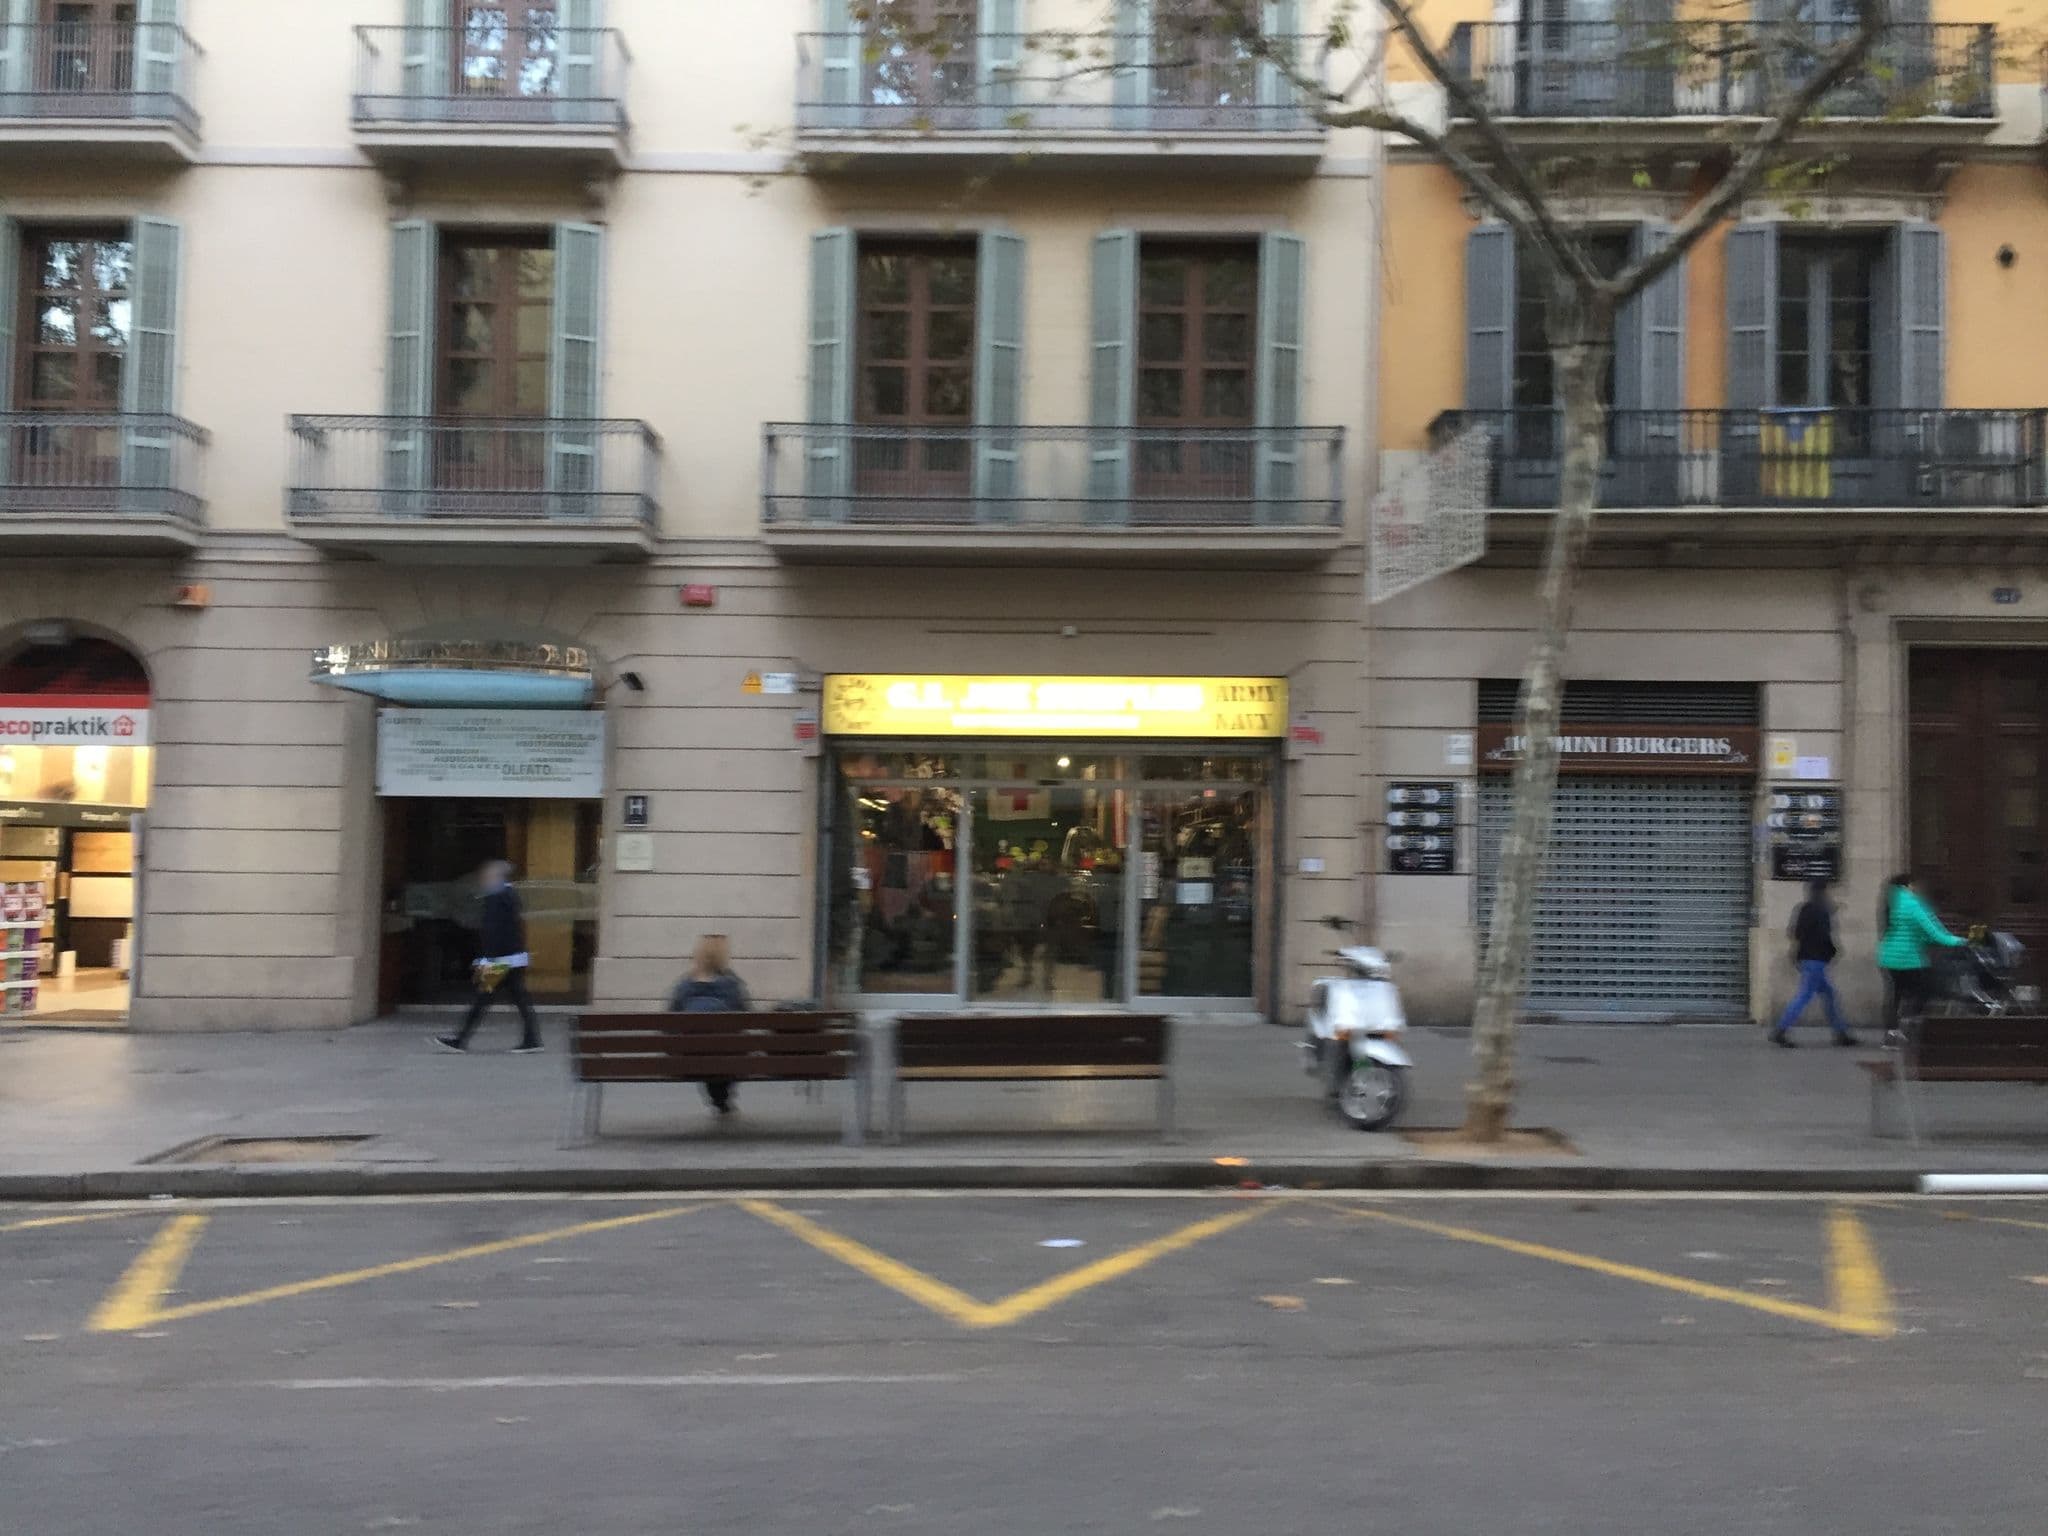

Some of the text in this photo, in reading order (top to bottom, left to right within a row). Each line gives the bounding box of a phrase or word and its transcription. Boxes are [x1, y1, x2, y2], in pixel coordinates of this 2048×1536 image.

[1216, 685, 1277, 702] ARMY
[0, 716, 109, 741] ecopraktik
[1216, 713, 1273, 730] NAVY
[1616, 736, 1731, 755] BURGERS
[502, 763, 552, 776] OLFATO
[629, 798, 643, 816] H
